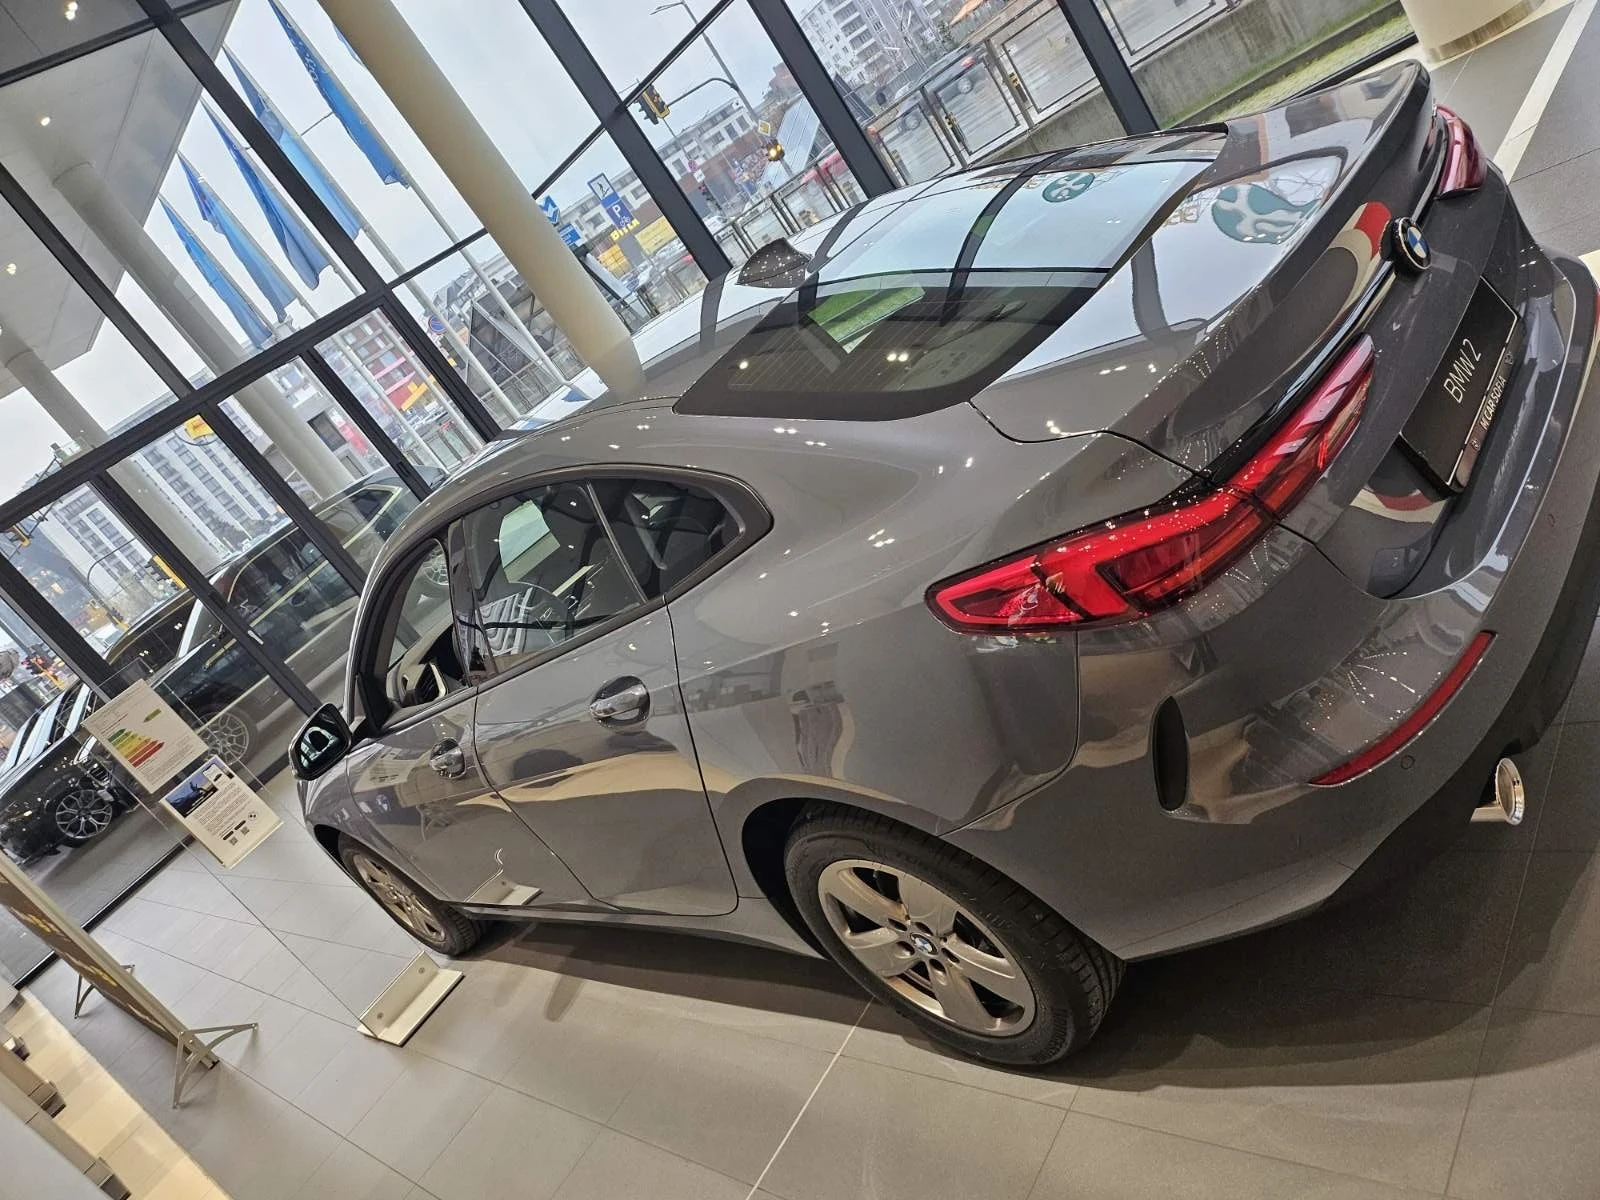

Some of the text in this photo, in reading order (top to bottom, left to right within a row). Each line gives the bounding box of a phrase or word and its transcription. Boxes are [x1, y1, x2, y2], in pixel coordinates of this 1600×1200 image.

[612, 204, 621, 218] P
[1443, 338, 1482, 403] BMW 2
[1480, 375, 1507, 430] M CAR SOFIA
